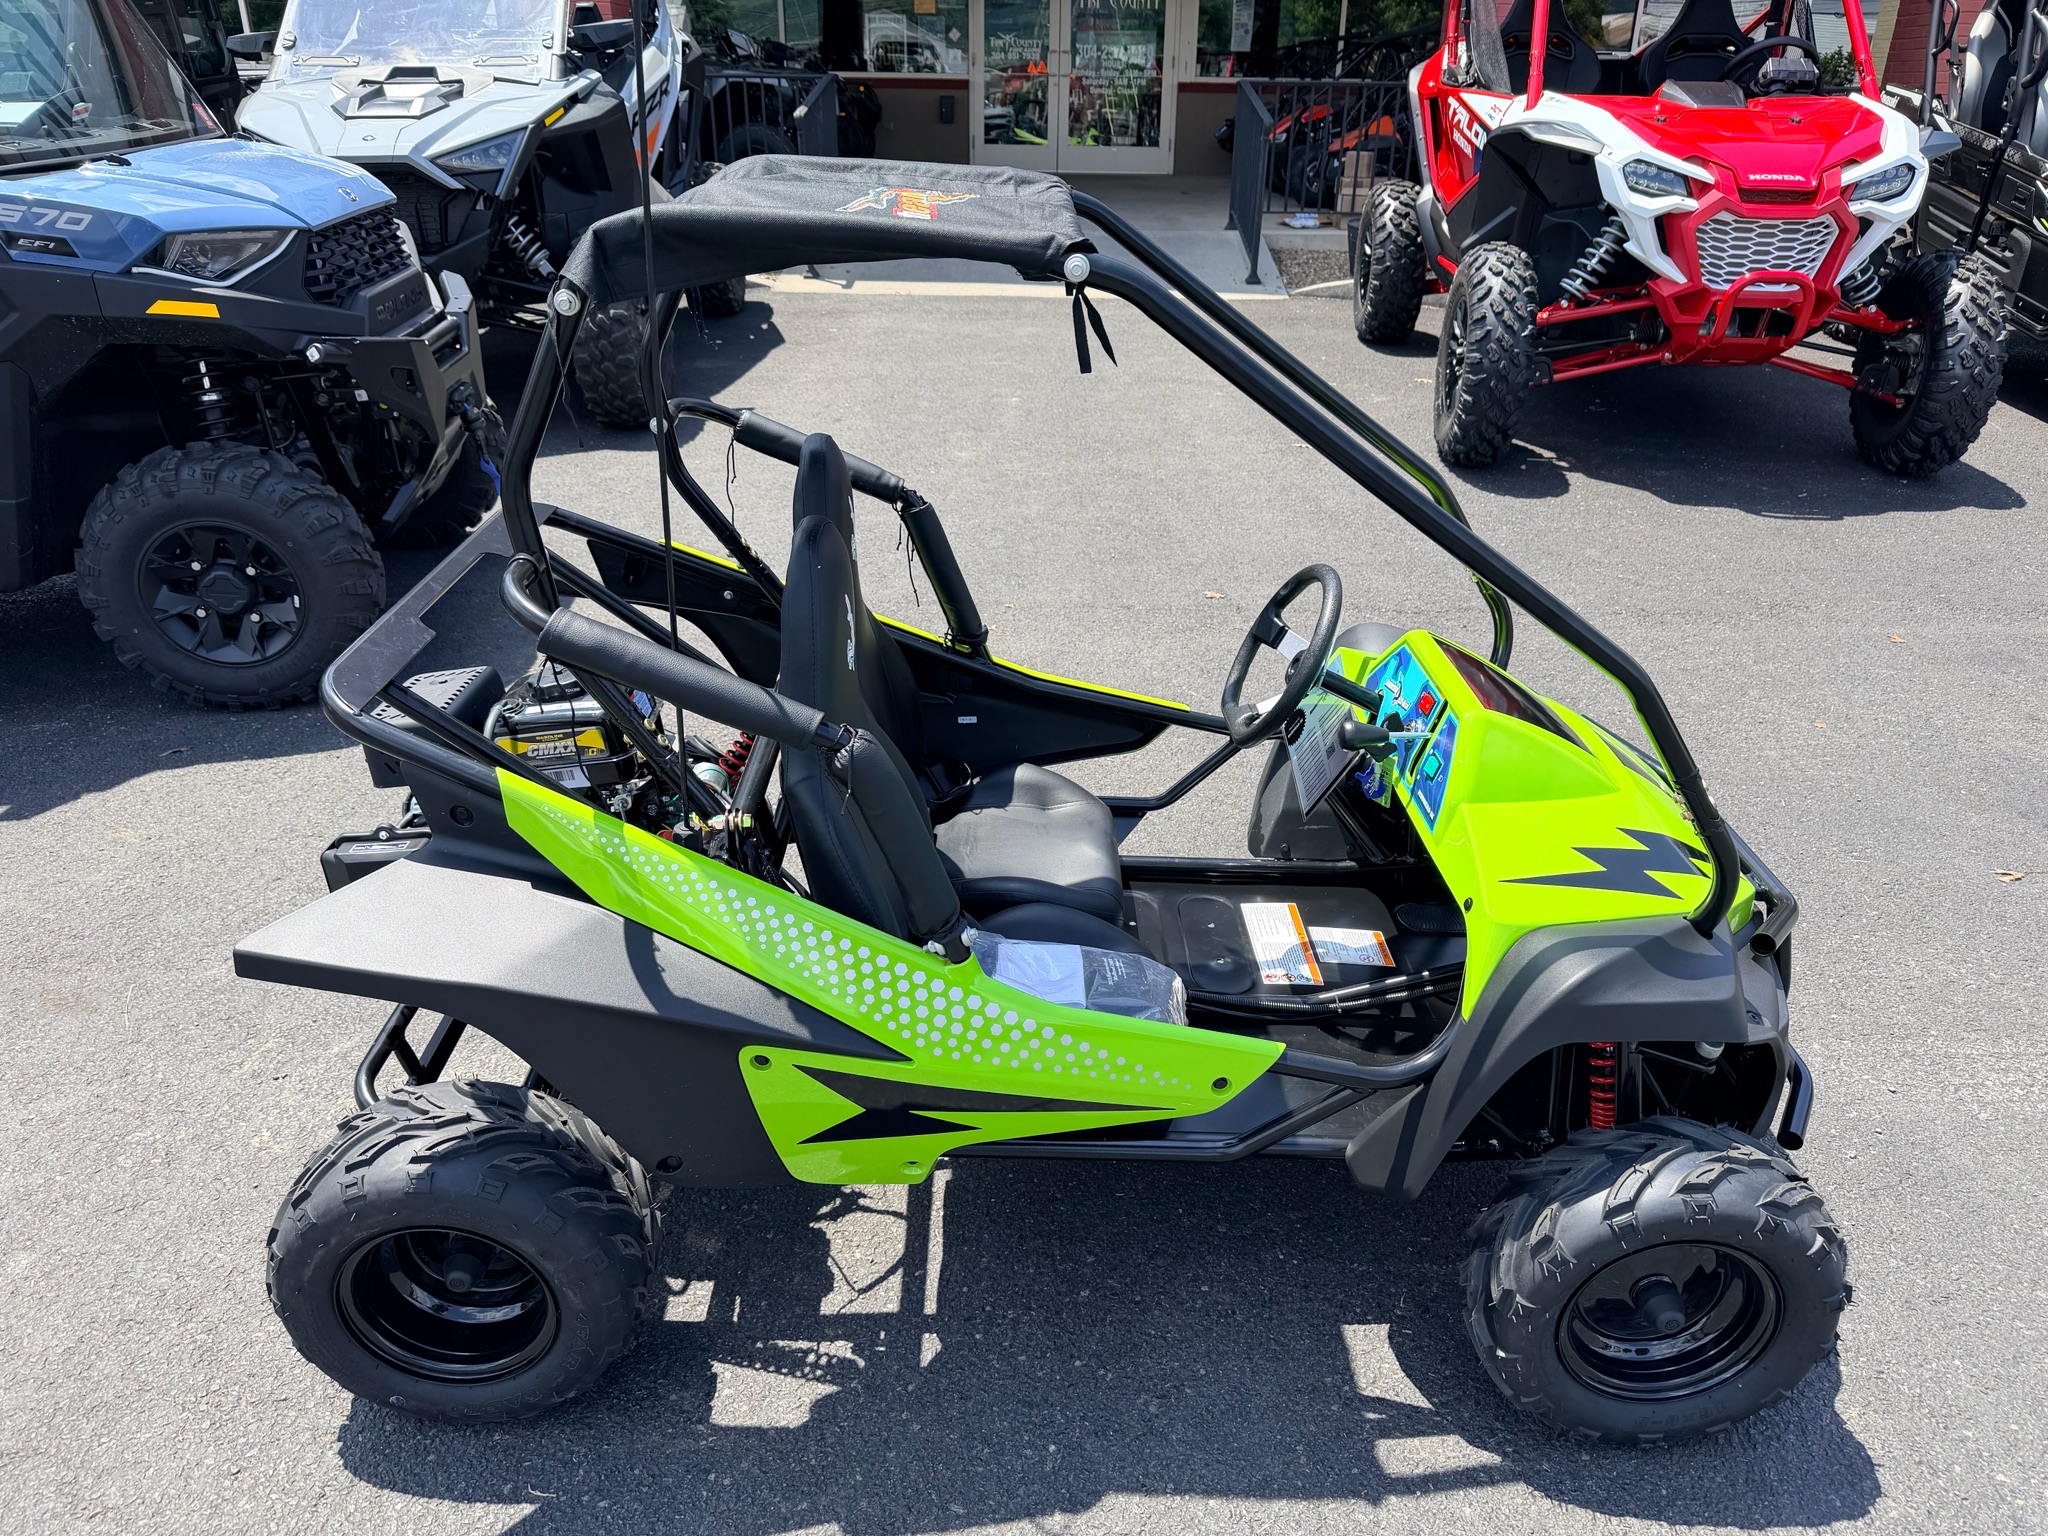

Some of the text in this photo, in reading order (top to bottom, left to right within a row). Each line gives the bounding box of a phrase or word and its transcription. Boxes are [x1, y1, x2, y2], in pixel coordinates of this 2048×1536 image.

[1452, 128, 1473, 159] HONDA
[1747, 173, 1807, 182] HONDA
[17, 238, 55, 249] EFI
[526, 740, 577, 758] CMXX
